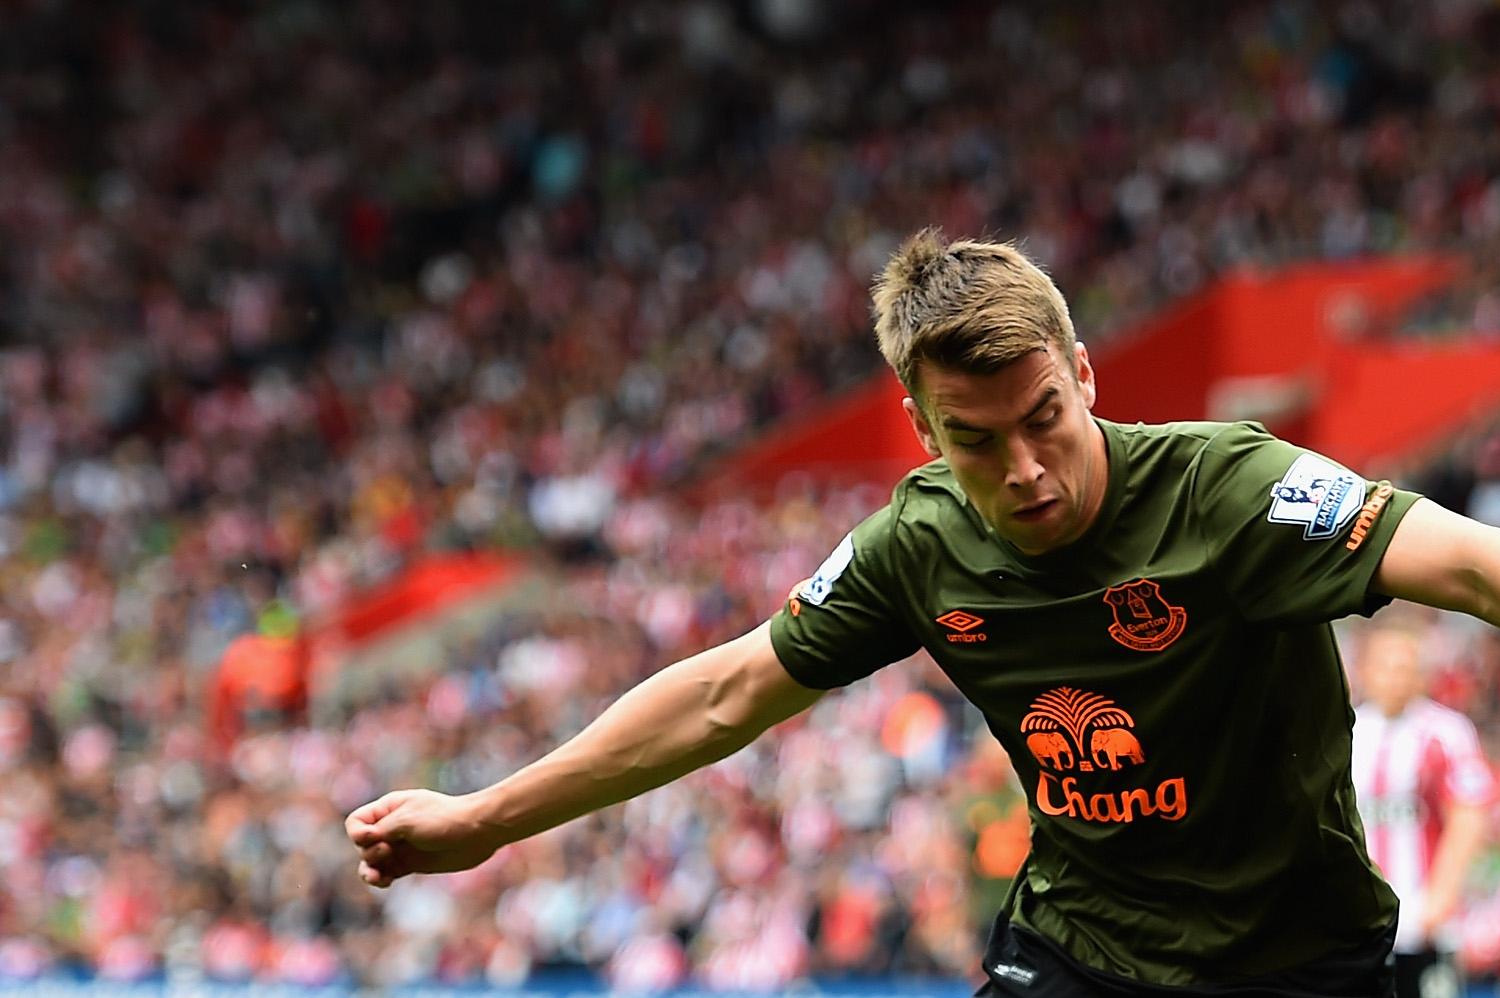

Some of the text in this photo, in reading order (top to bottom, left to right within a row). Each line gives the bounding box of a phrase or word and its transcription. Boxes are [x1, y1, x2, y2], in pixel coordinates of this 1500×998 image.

[1346, 485, 1394, 551] umbro
[946, 633, 987, 642] umbro
[1036, 770, 1187, 823] Chang
